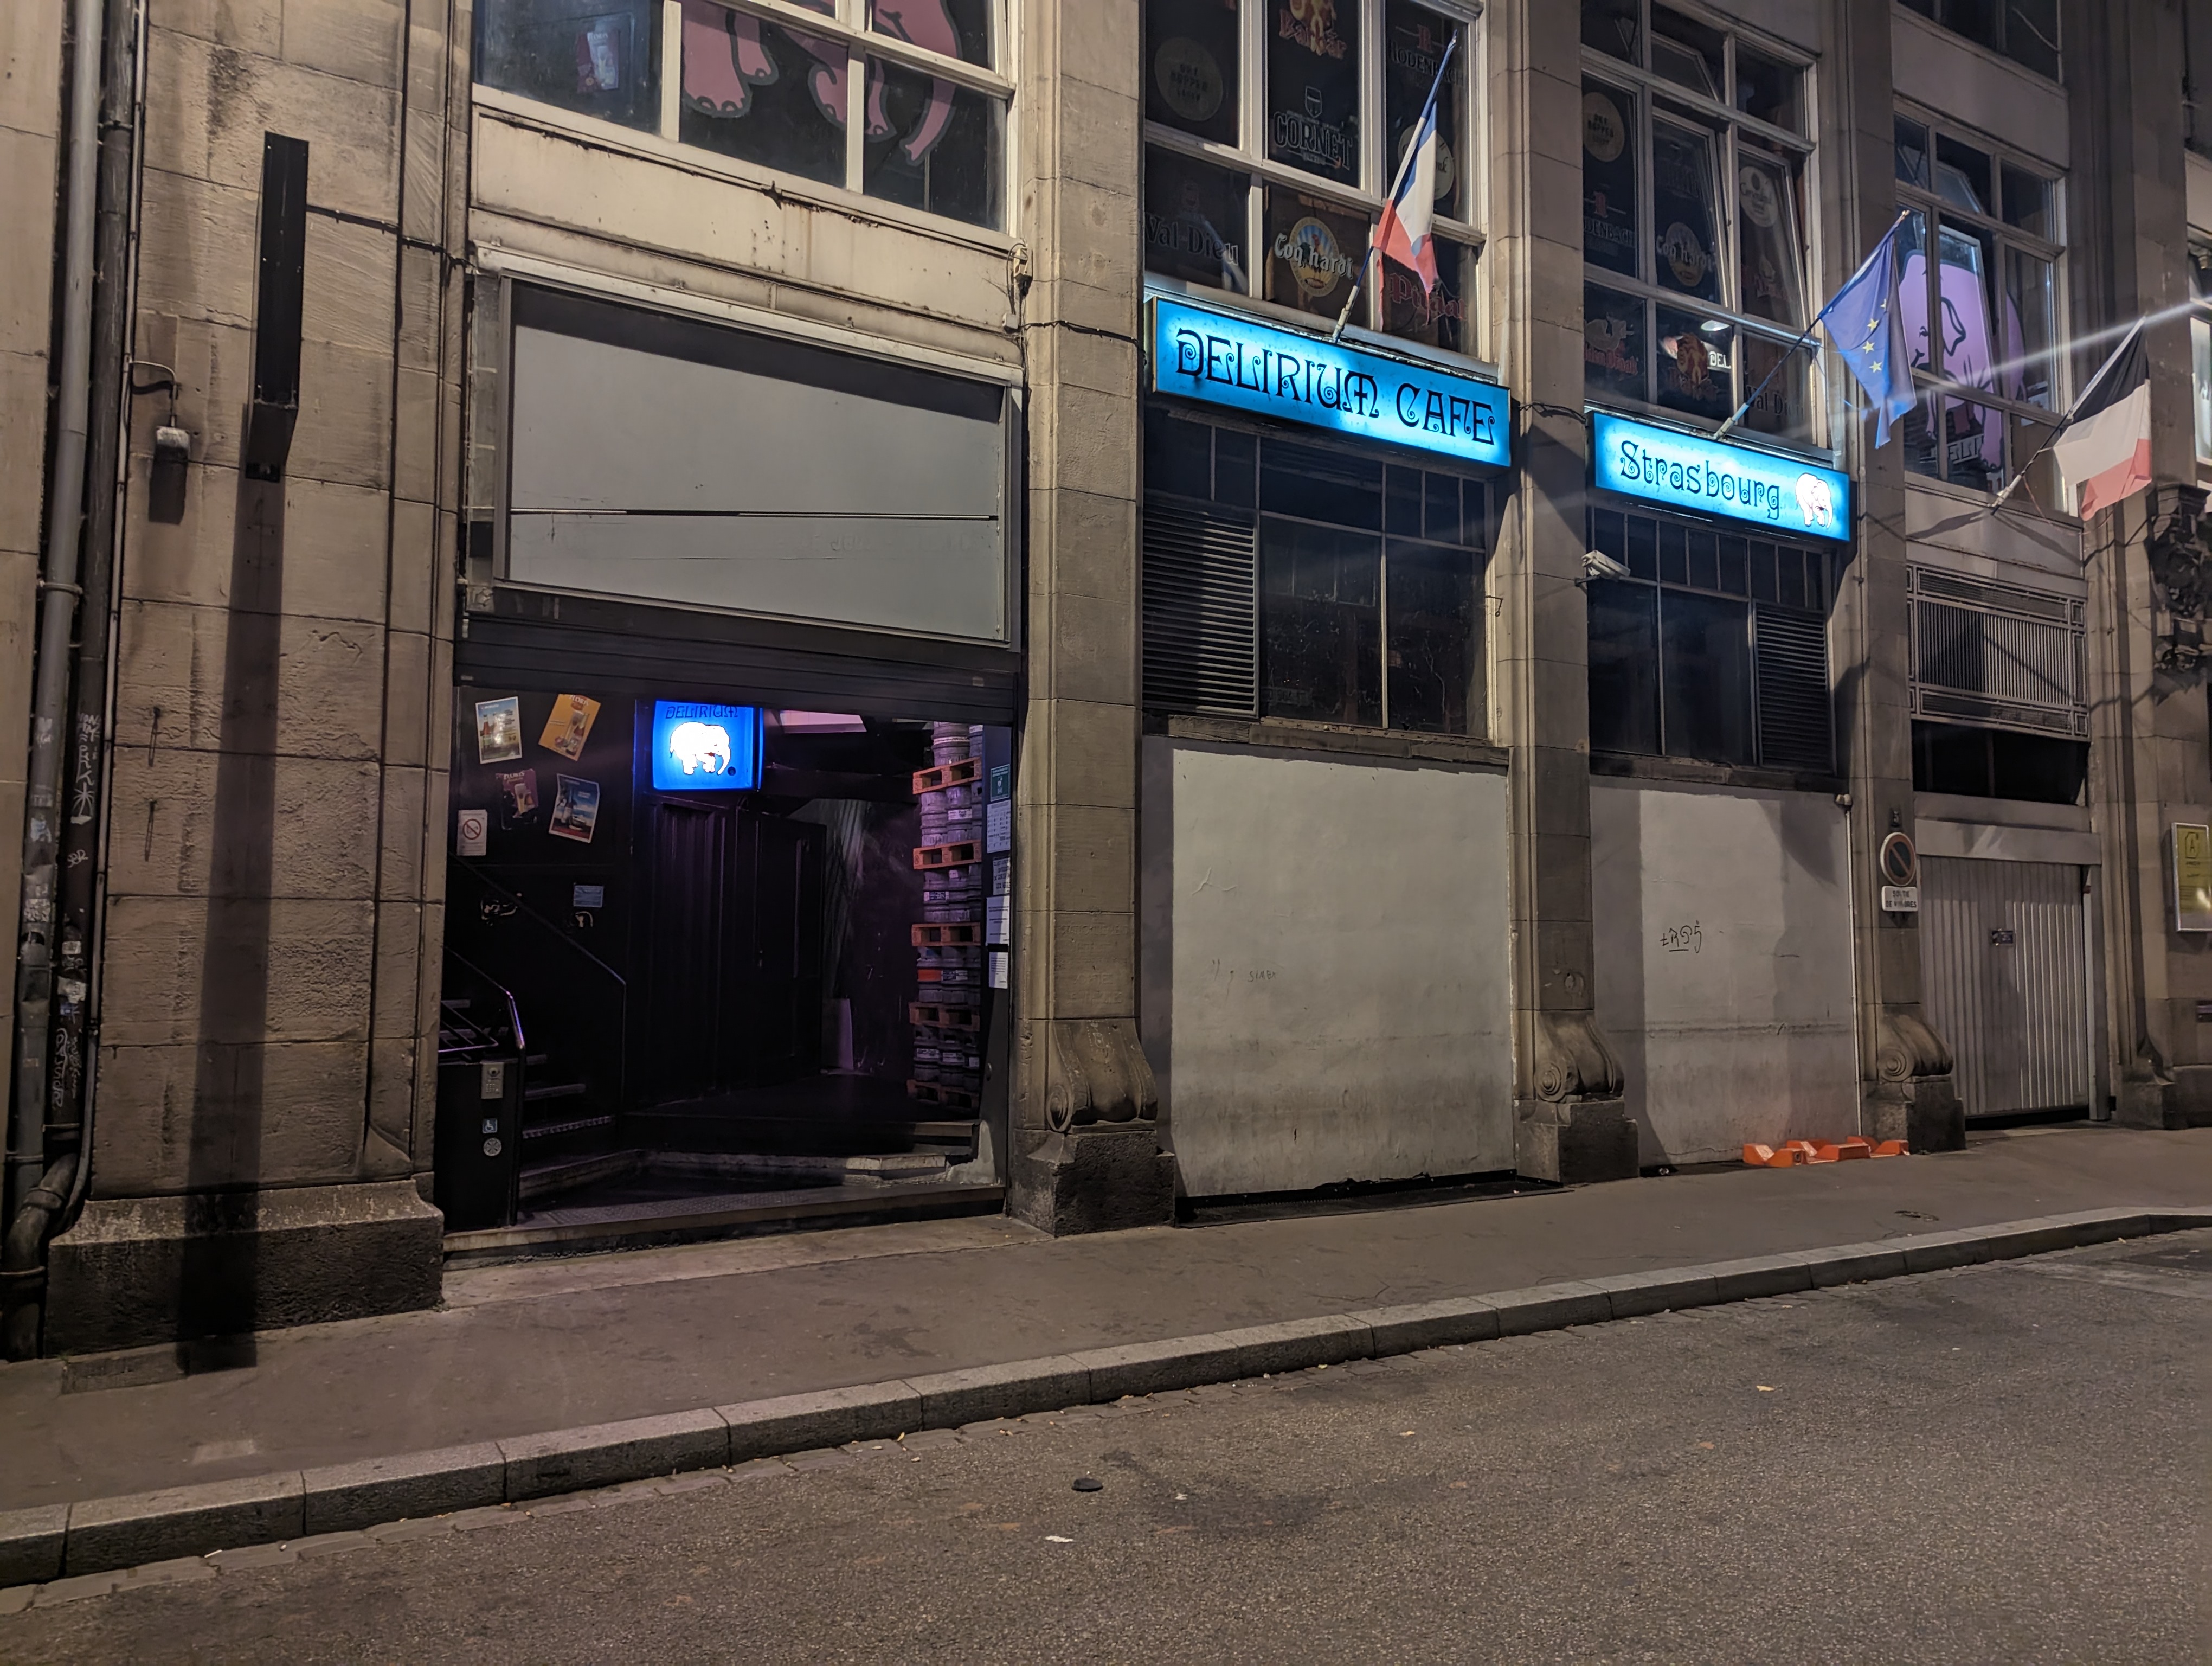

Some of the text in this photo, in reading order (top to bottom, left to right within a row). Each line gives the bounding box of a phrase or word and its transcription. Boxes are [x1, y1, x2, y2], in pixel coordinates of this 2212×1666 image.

[1274, 111, 1353, 171] CORNET
[1274, 232, 1354, 280] Coq hardi
[1175, 327, 1495, 446] DELIRIUM CAFE
[1620, 440, 1780, 520] Strasbourg
[665, 705, 738, 719] DELIRIUM
